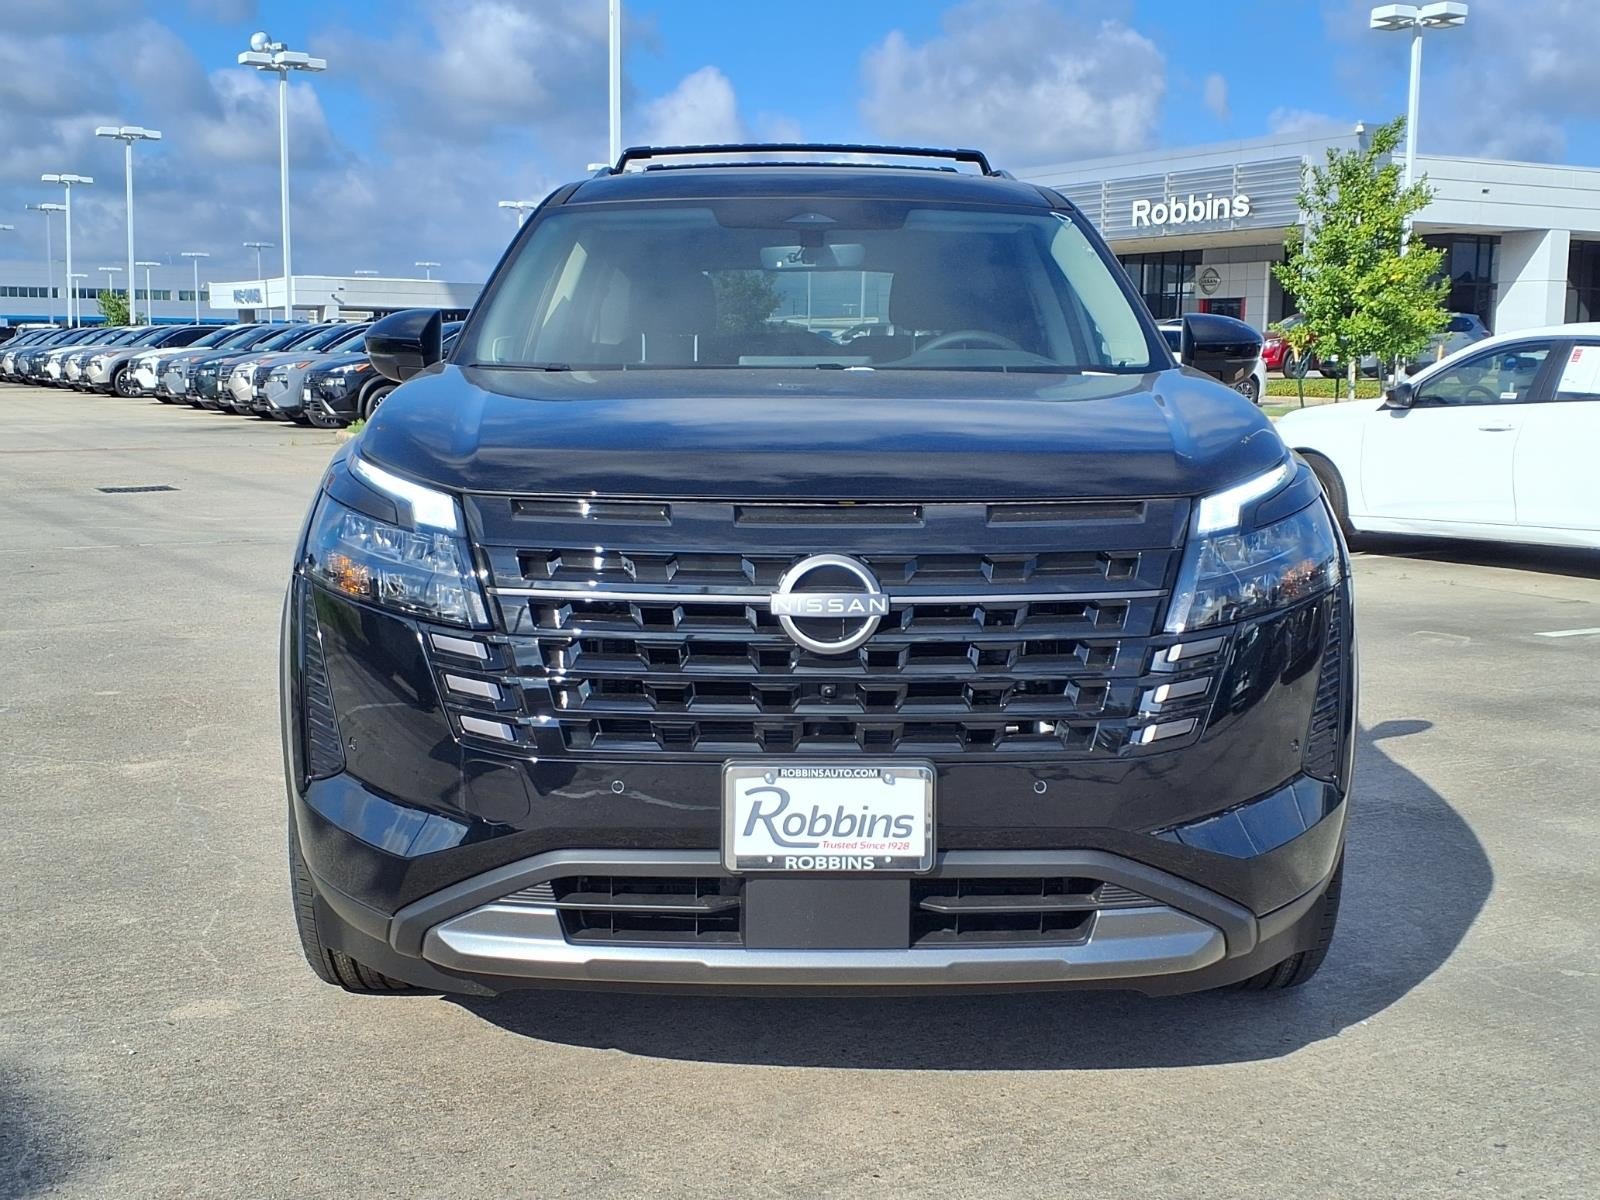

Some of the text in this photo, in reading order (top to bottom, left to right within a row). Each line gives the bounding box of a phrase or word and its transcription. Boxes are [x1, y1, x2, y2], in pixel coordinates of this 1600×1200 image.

[1132, 193, 1250, 227] Robbins
[773, 598, 886, 613] NISSAN
[780, 768, 878, 778] ROBBINSAUTO.COM
[743, 786, 915, 848] Robbins
[823, 841, 910, 850] Trusted Since 1928
[785, 856, 875, 870] ROBBINS
